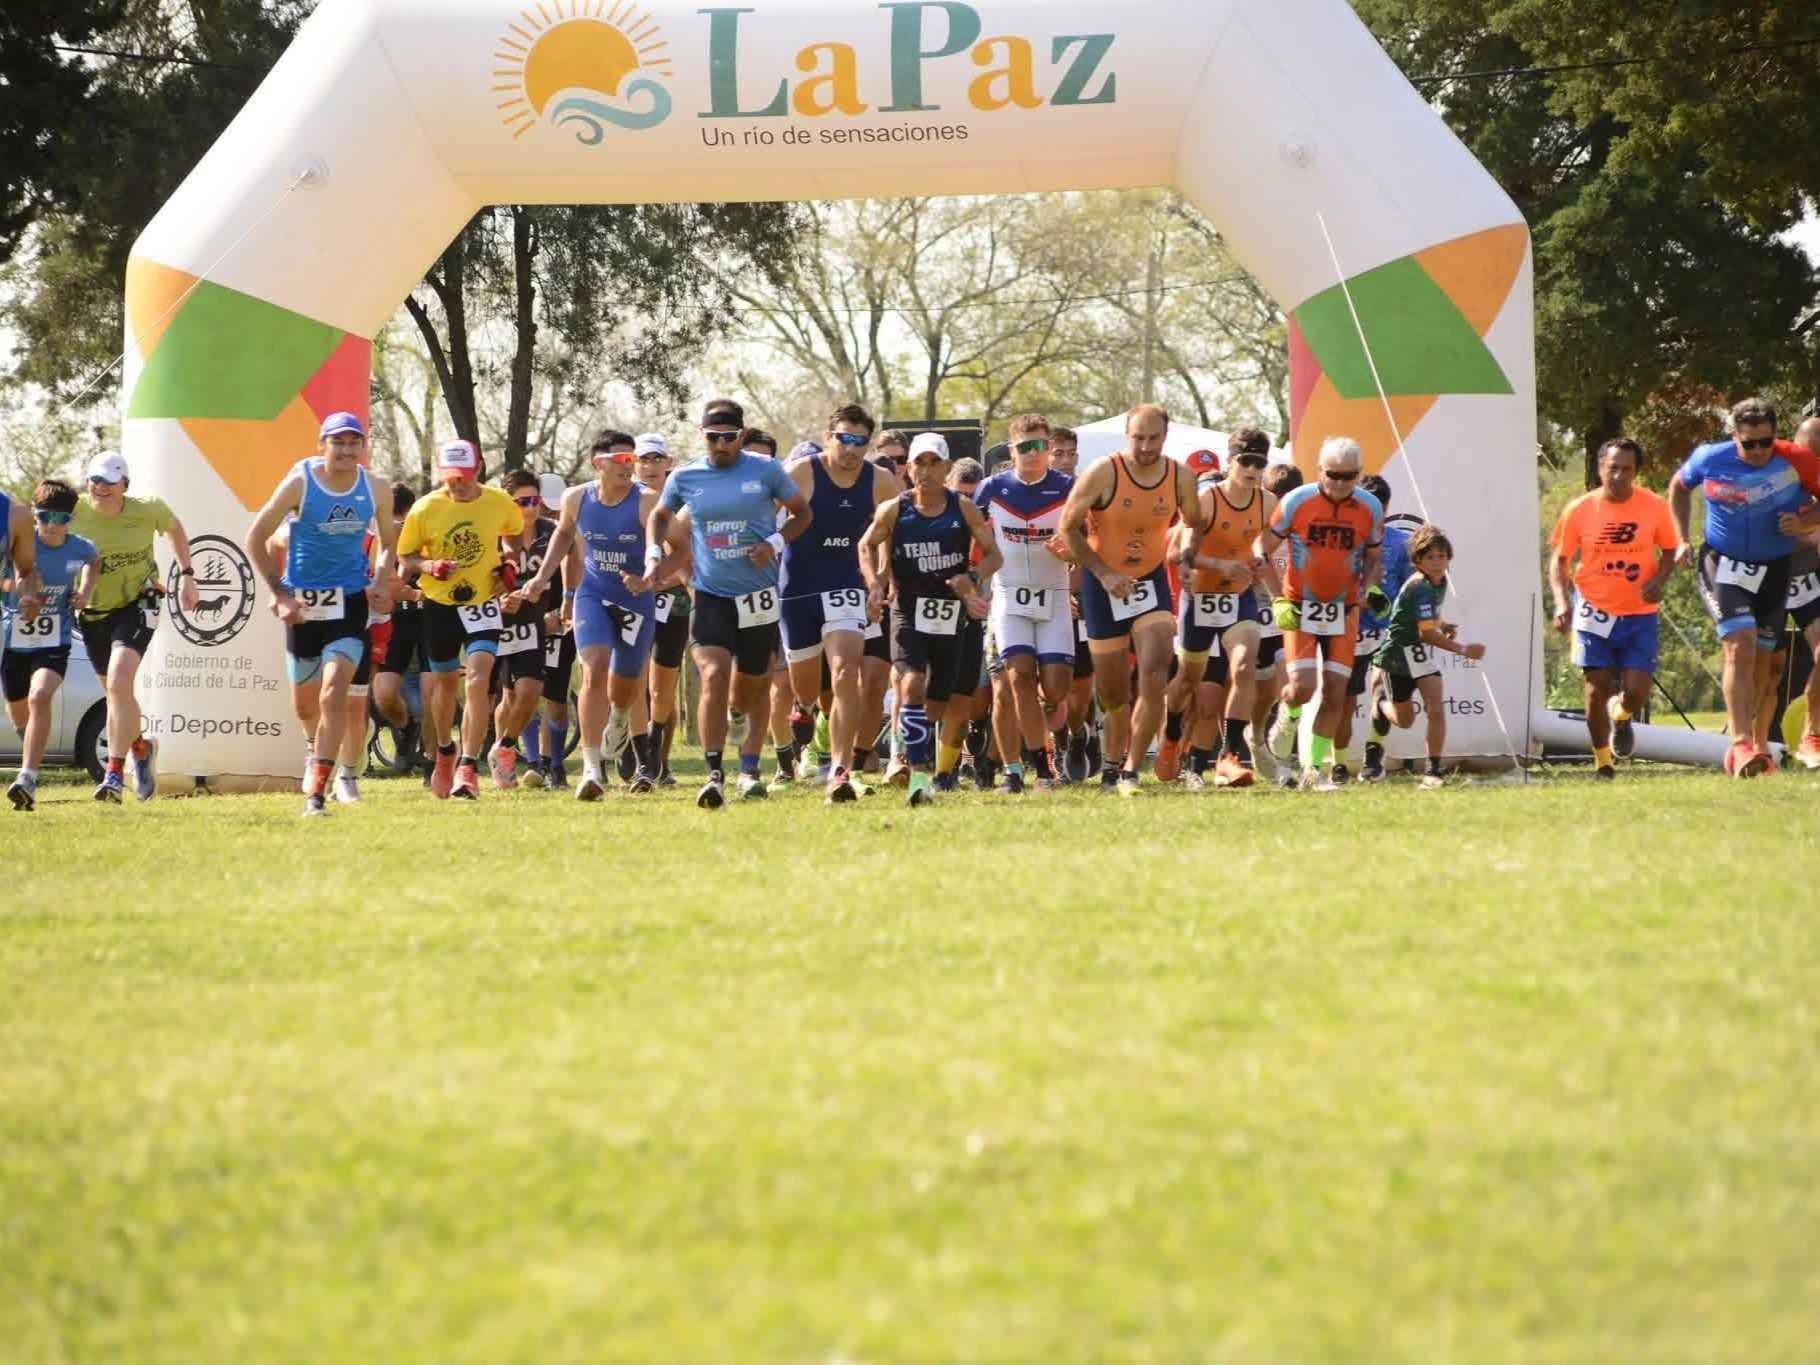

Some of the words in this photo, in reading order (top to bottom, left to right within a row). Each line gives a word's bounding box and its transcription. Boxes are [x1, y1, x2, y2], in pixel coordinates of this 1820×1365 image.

[702, 127, 735, 146] Un
[744, 125, 774, 145] río
[782, 124, 811, 145] de
[820, 122, 969, 144] sensaciones
[823, 537, 850, 547] ARG
[903, 541, 941, 558] TEAM
[302, 588, 337, 607] 92
[743, 590, 774, 614] 18
[829, 589, 861, 607] 59
[1016, 587, 1047, 607] 01
[1201, 595, 1233, 614] 56
[464, 601, 498, 622] 36
[922, 599, 953, 620] 85
[1307, 602, 1339, 622] 29
[19, 616, 53, 636] 39
[165, 653, 229, 669] Gobierno
[234, 656, 253, 670] de
[155, 672, 201, 688] Ciudad
[205, 674, 223, 689] de
[229, 674, 247, 689] La
[253, 675, 279, 691] Paz
[170, 714, 281, 739] Deportes
